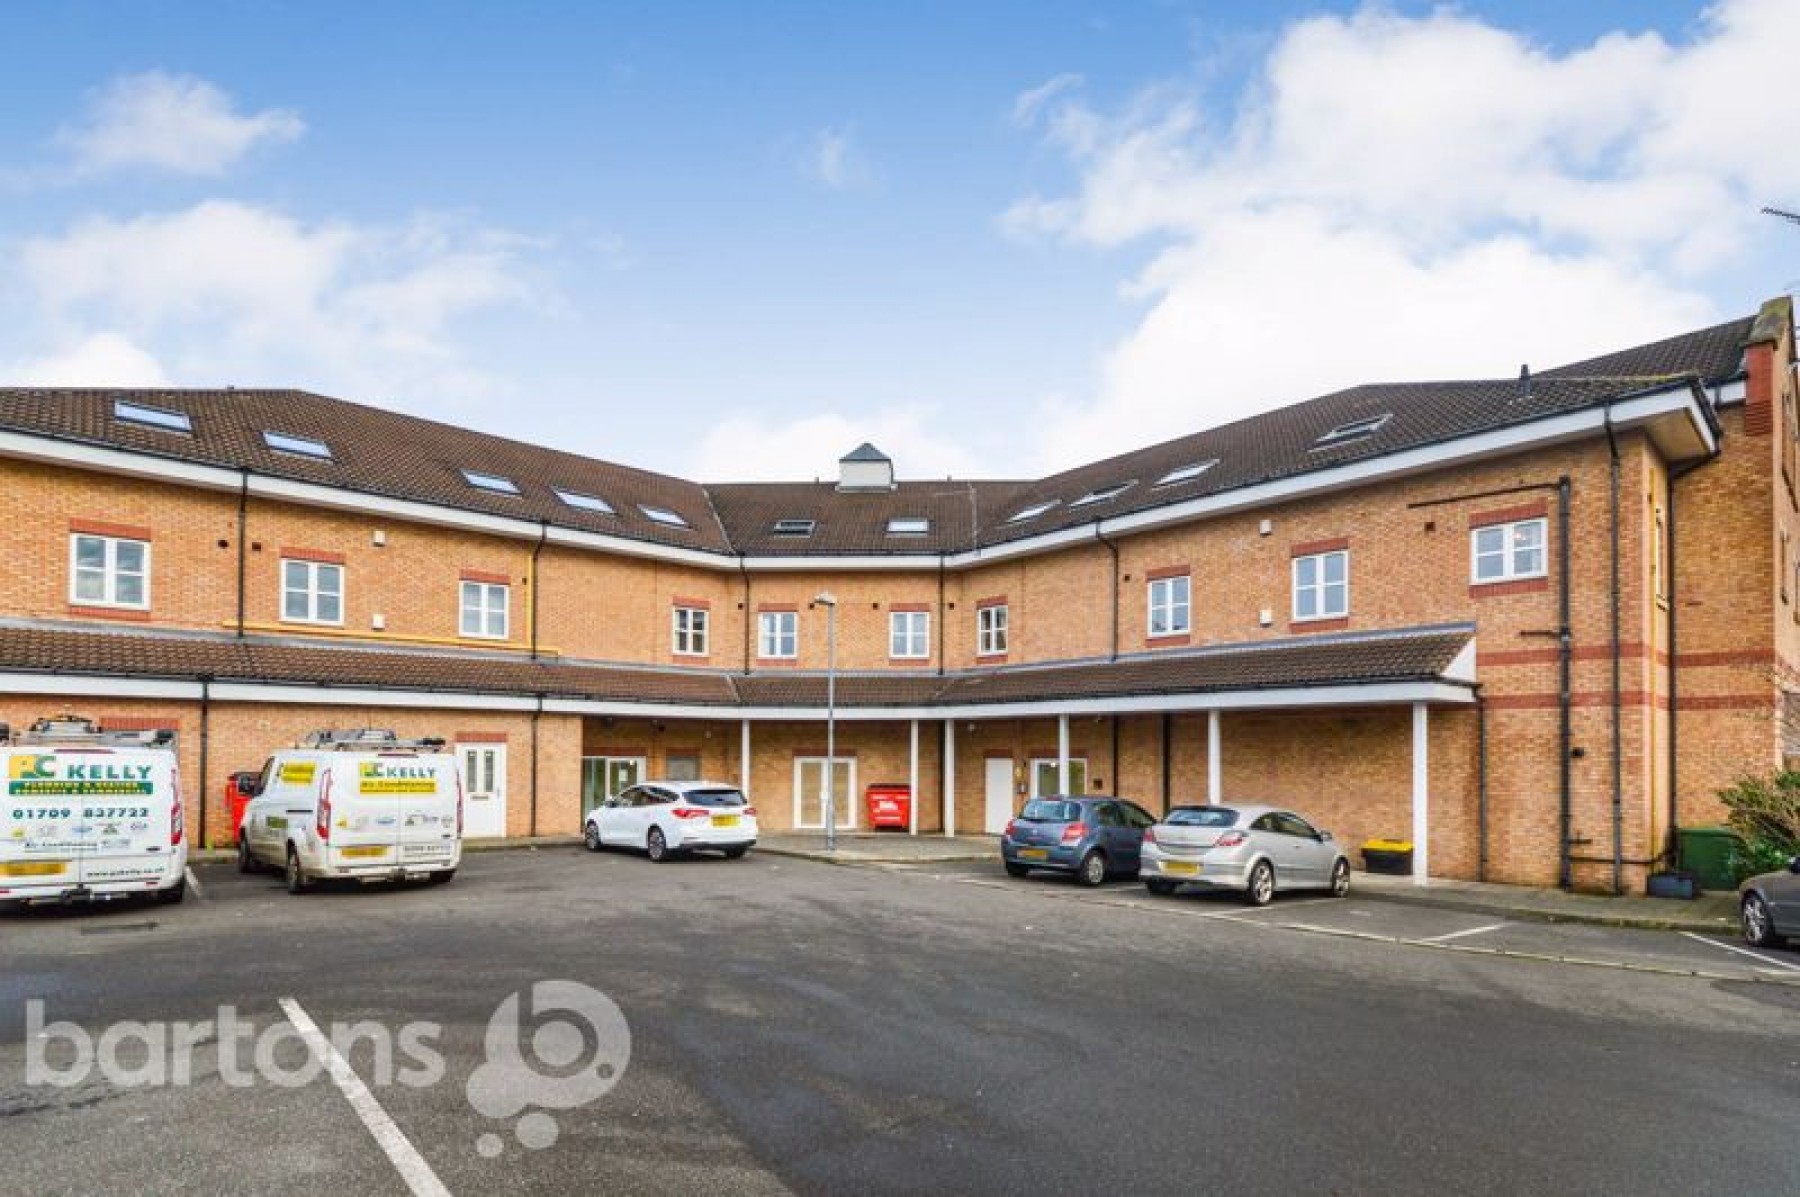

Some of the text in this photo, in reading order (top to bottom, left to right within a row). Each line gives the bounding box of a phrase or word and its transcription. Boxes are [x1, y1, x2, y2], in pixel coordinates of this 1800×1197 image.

[67, 764, 151, 779] KELLY
[386, 766, 435, 778] KELLY
[12, 807, 71, 819] 01709
